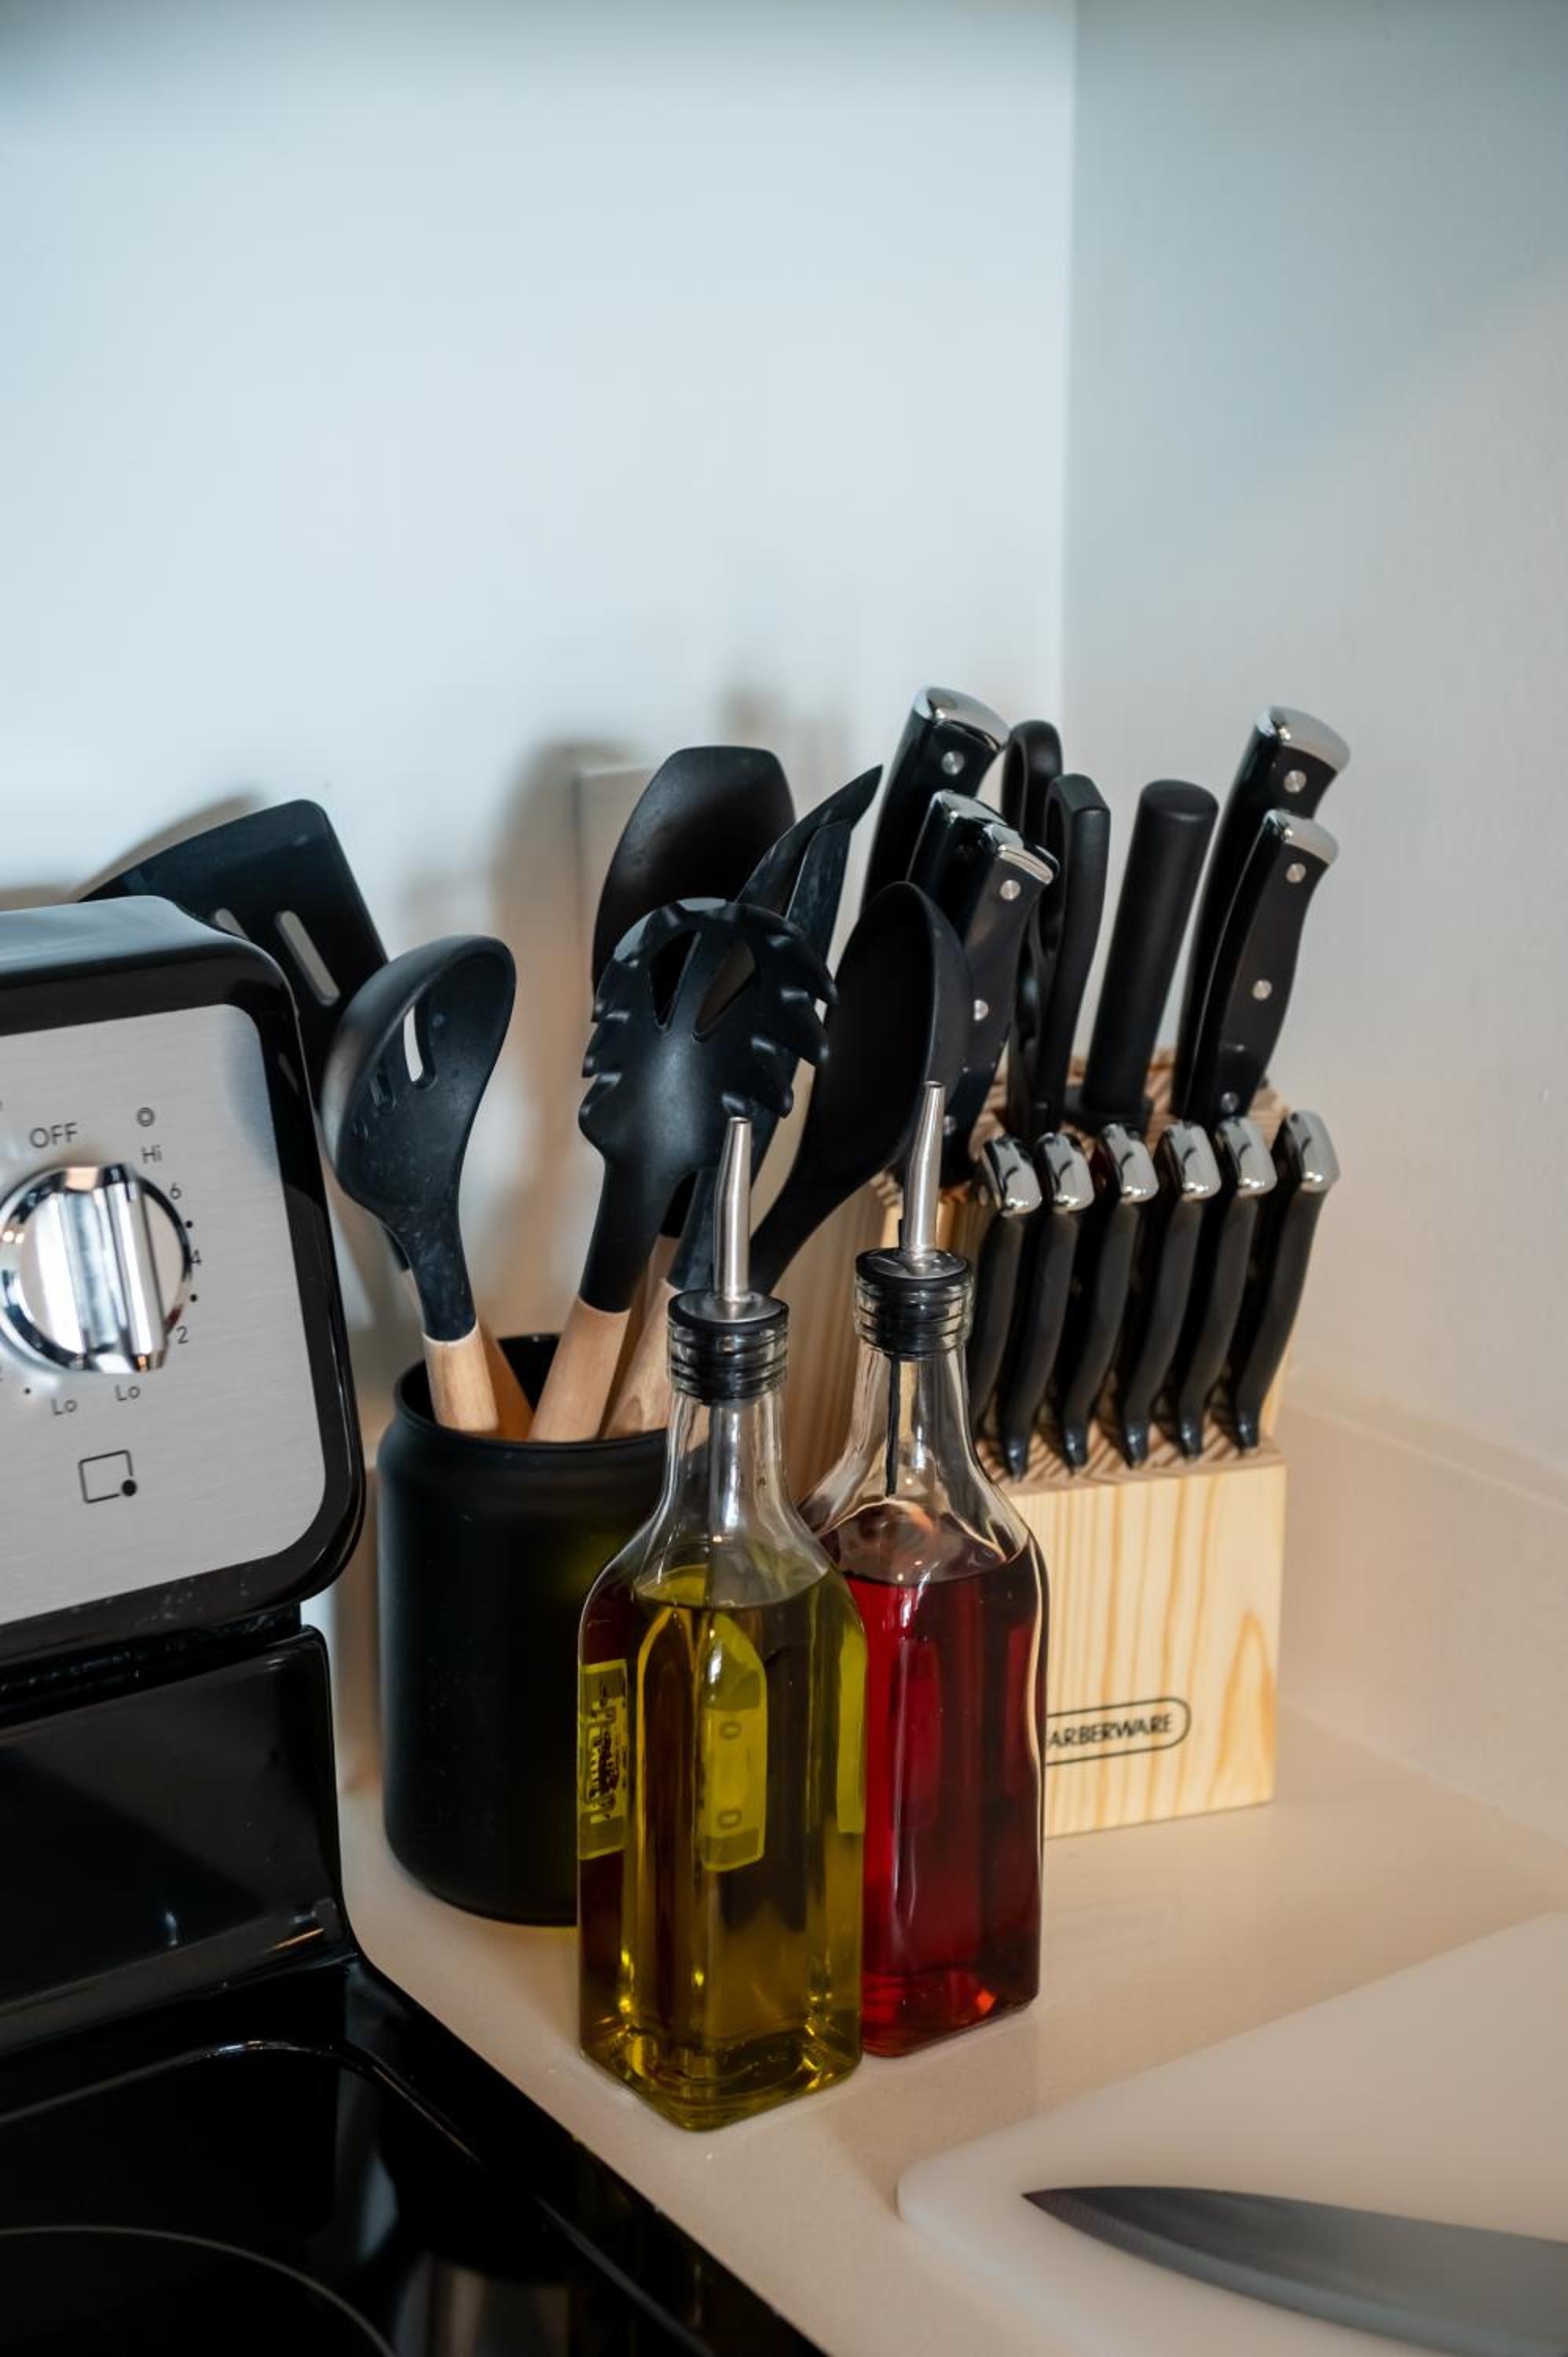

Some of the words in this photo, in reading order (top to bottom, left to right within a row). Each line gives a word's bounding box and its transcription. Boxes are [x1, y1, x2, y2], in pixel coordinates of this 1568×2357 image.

[30, 1122, 78, 1149] OFF
[141, 1145, 162, 1164] Hi
[170, 1182, 181, 1200] 6
[176, 1325, 189, 1344] 2
[115, 1384, 141, 1402] Lo
[51, 1398, 78, 1416] Lo
[1049, 1713, 1171, 1748] ARBERWARE
